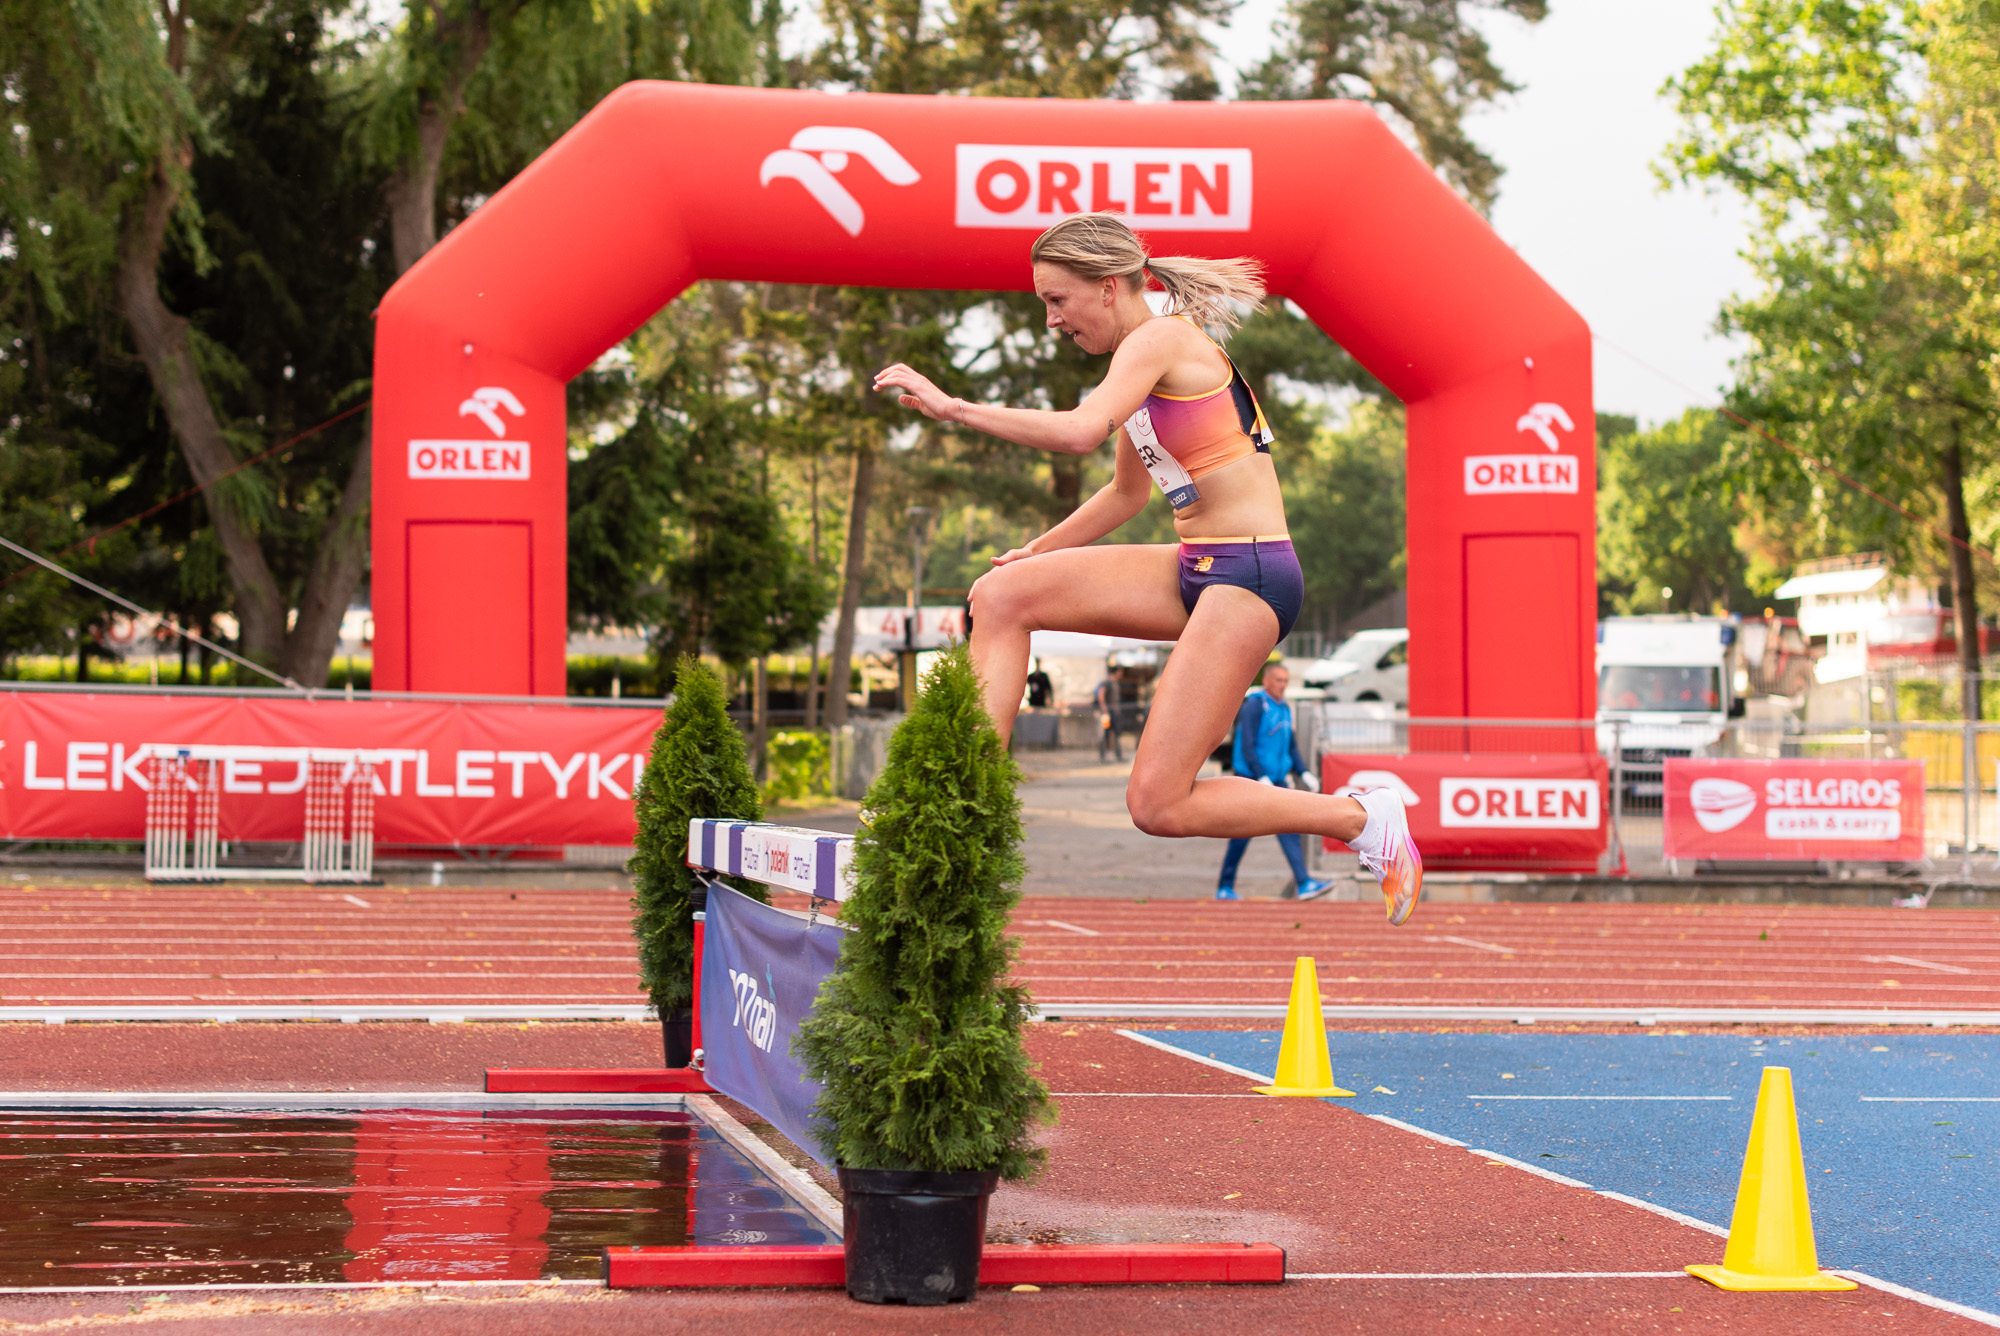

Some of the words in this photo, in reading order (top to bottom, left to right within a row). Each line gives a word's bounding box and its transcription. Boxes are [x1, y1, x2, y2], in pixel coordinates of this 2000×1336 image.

[975, 159, 1229, 215] ORLEN
[416, 448, 520, 471] ORLEN
[1472, 463, 1570, 486] ORLEN
[1452, 788, 1587, 818] ORLEN
[1765, 778, 1901, 806] SELGROS
[1778, 815, 1819, 830] cash
[1843, 817, 1891, 836] carry
